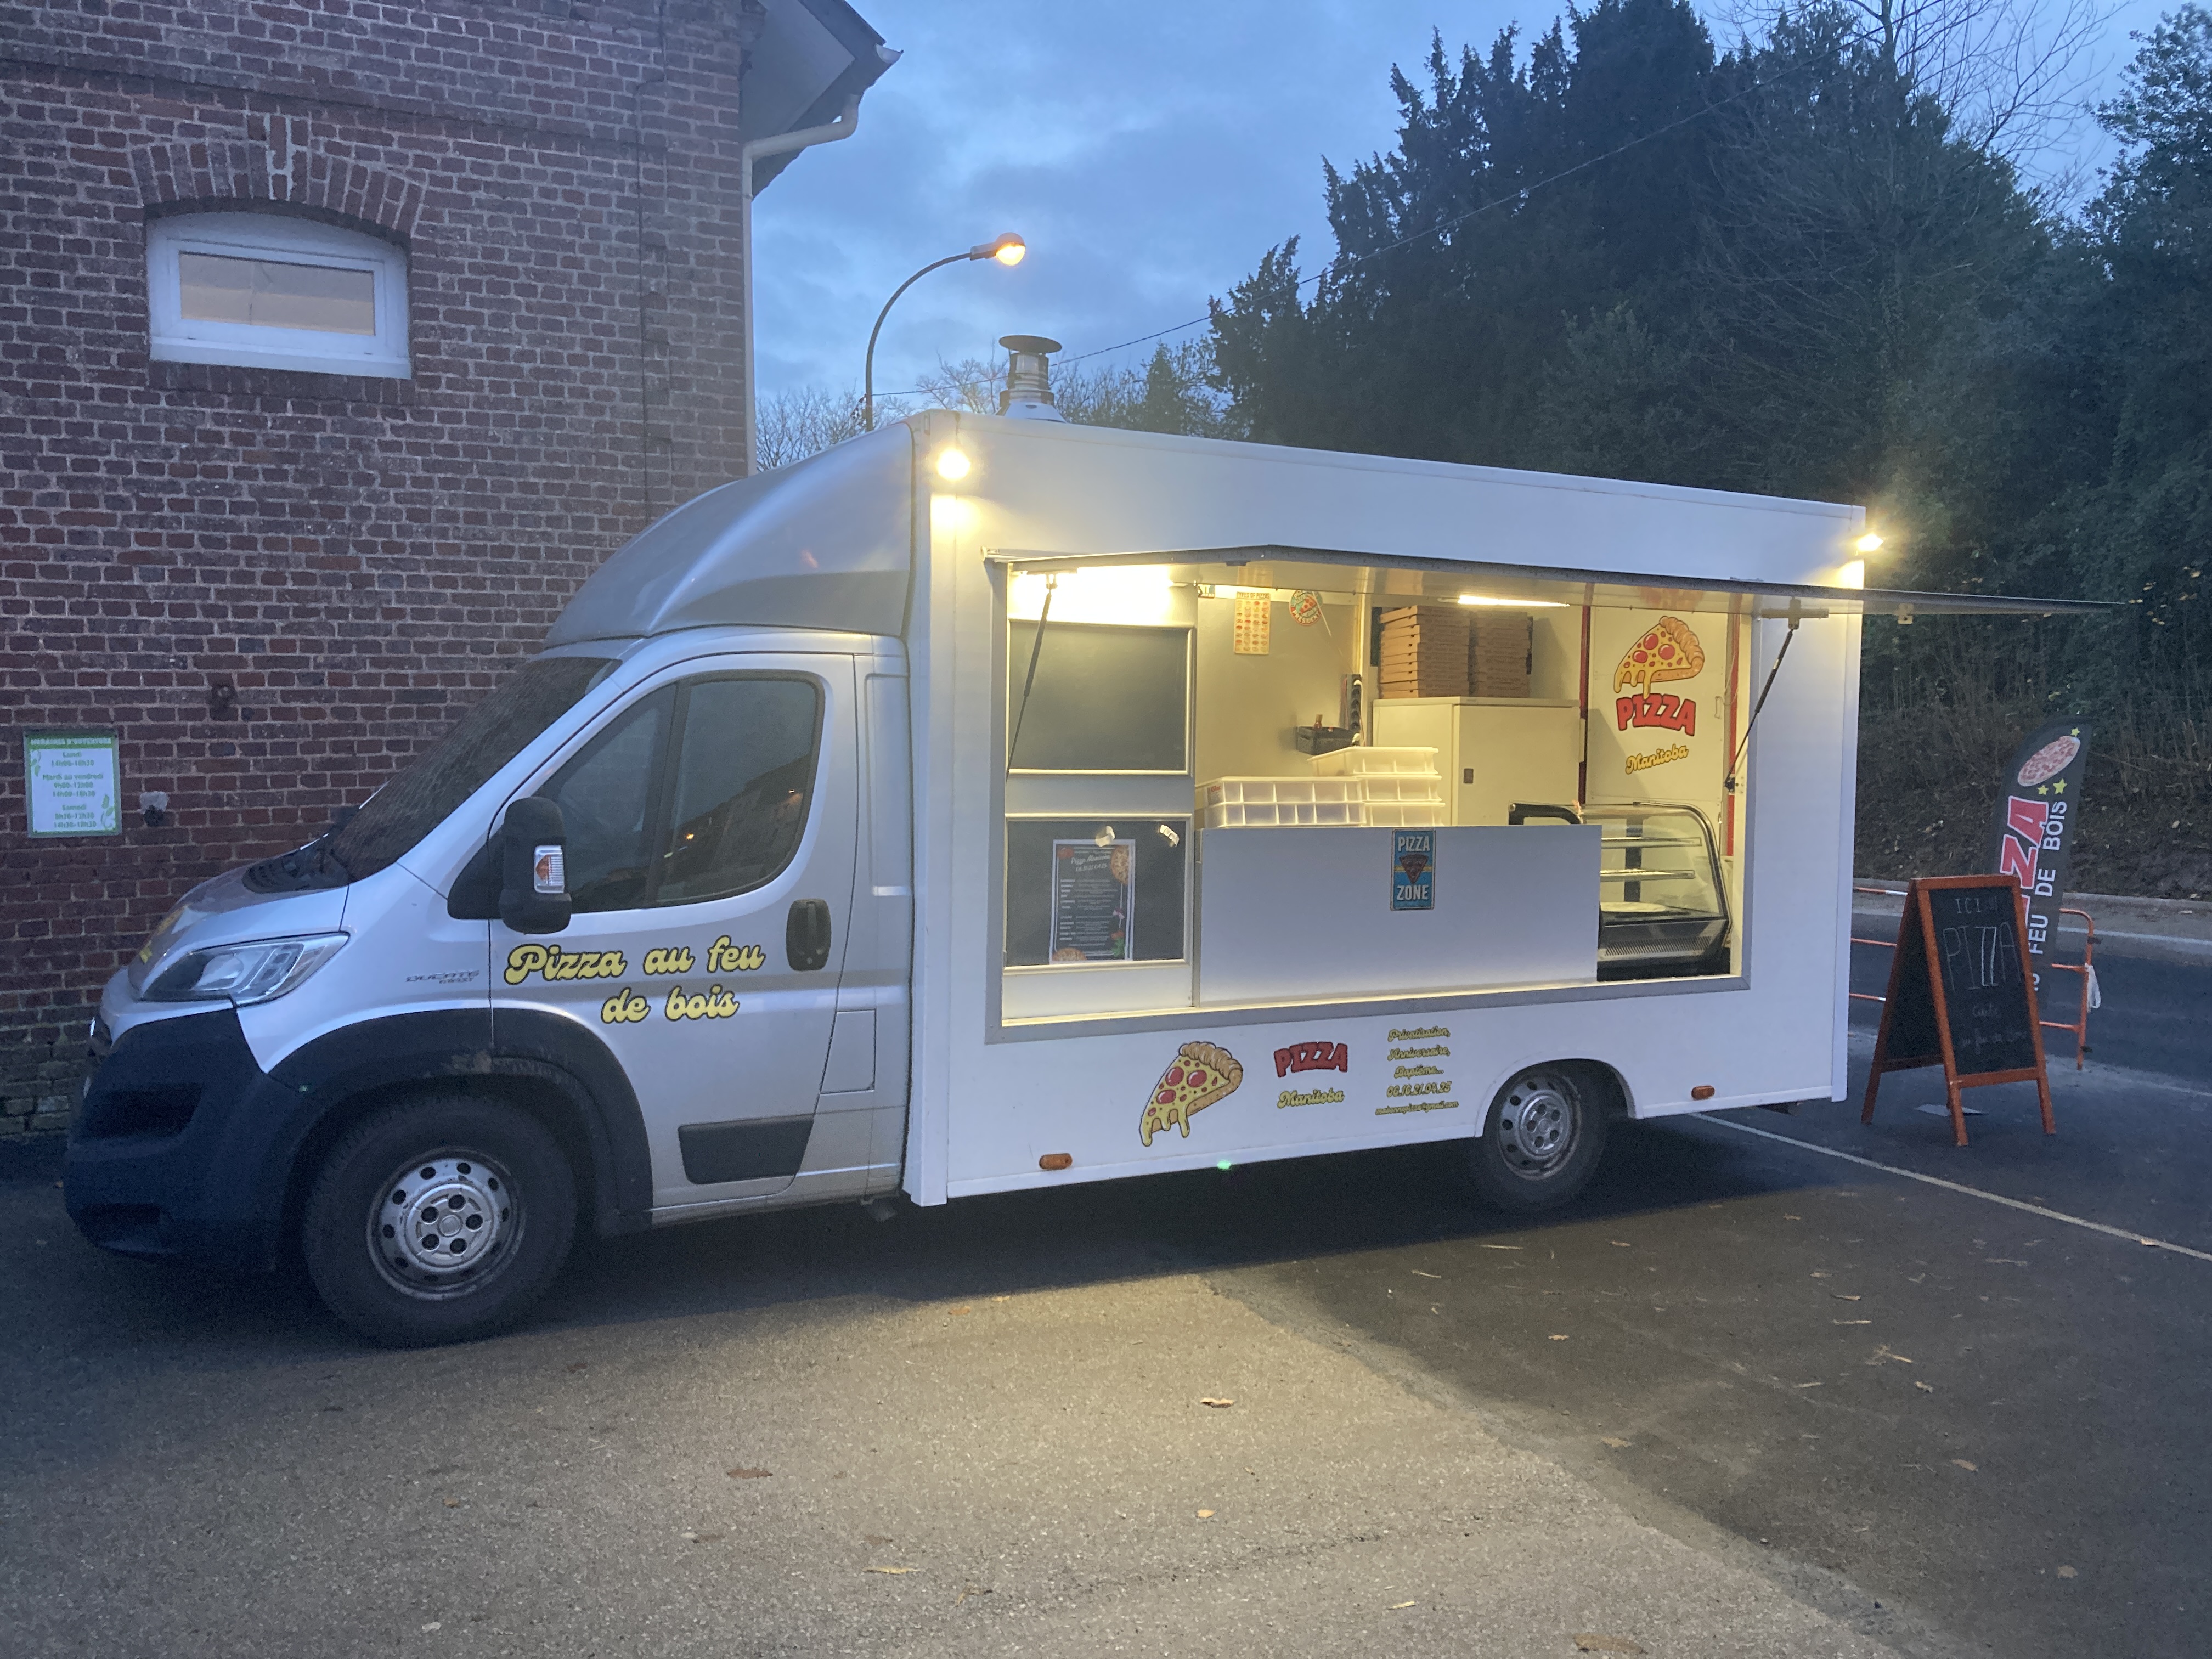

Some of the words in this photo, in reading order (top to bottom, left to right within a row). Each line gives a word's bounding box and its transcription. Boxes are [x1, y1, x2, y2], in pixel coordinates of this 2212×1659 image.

[1616, 693, 1696, 736] PIZZA
[1625, 743, 1689, 775] Manitoba
[2042, 800, 2067, 850] BOIS
[1398, 836, 1430, 852] PIZZA
[1397, 884, 1429, 900] ZONE
[2035, 868, 2056, 896] DE
[1955, 898, 1982, 915] ICI
[2029, 915, 2049, 955] FEU
[504, 943, 628, 985] Pizza
[643, 946, 696, 975] au
[707, 935, 766, 974] feu
[1943, 922, 2022, 992] PIZZA
[601, 987, 651, 1024] de
[665, 984, 741, 1022] bois
[1387, 1025, 1451, 1042] Privatisation,
[1274, 1041, 1348, 1078] PIZZA
[1387, 1045, 1450, 1061] Anniversaire,
[1277, 1087, 1345, 1109] Manitoba
[1386, 1081, 1452, 1098] 06.16.21.04.25
